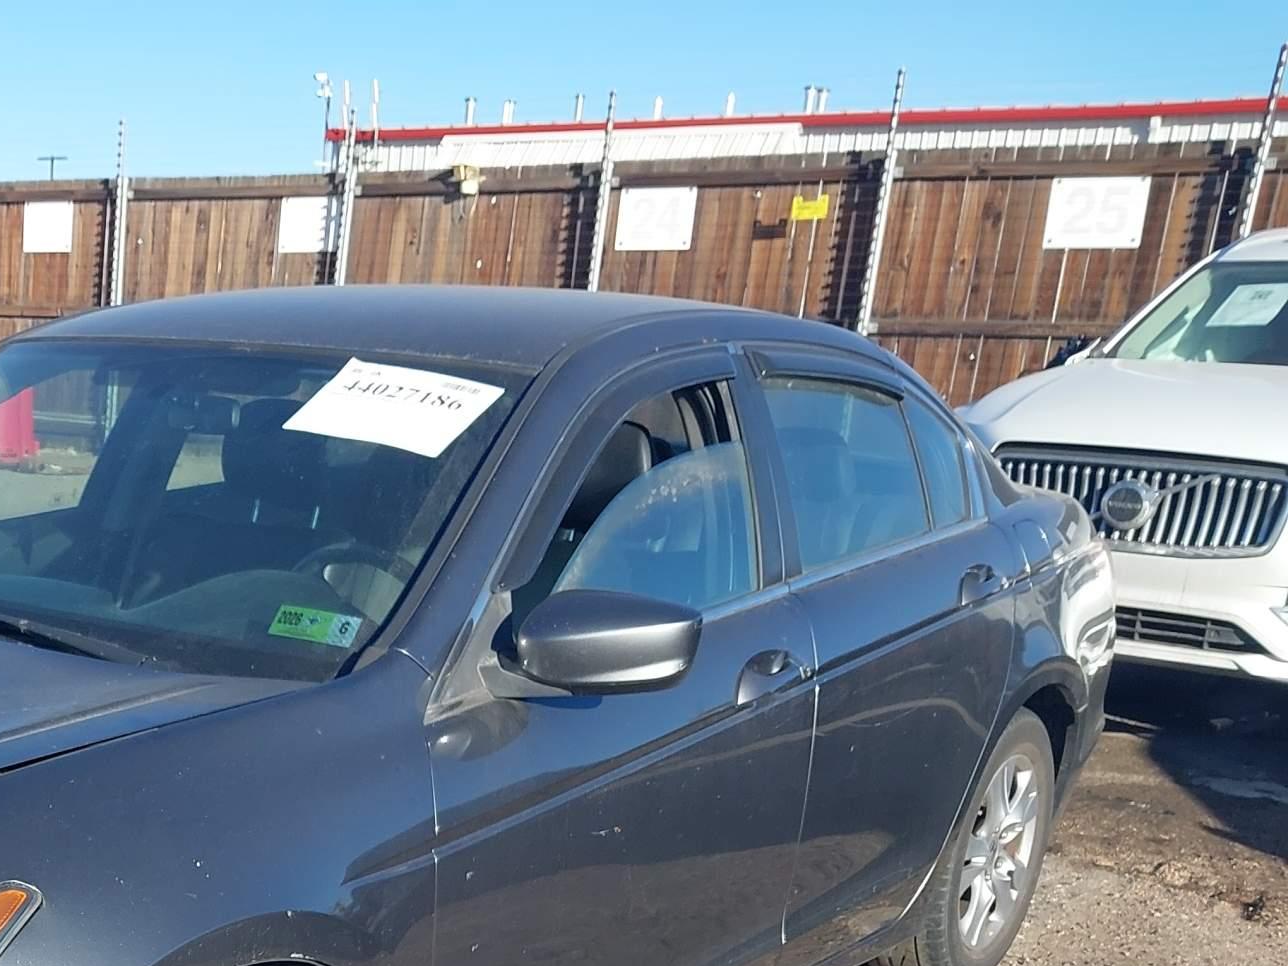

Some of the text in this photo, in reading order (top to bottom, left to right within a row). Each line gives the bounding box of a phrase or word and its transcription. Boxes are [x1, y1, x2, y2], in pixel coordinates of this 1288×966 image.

[1061, 186, 1131, 234] 25
[343, 379, 463, 411] 44027186
[277, 610, 352, 635] 2026 6
